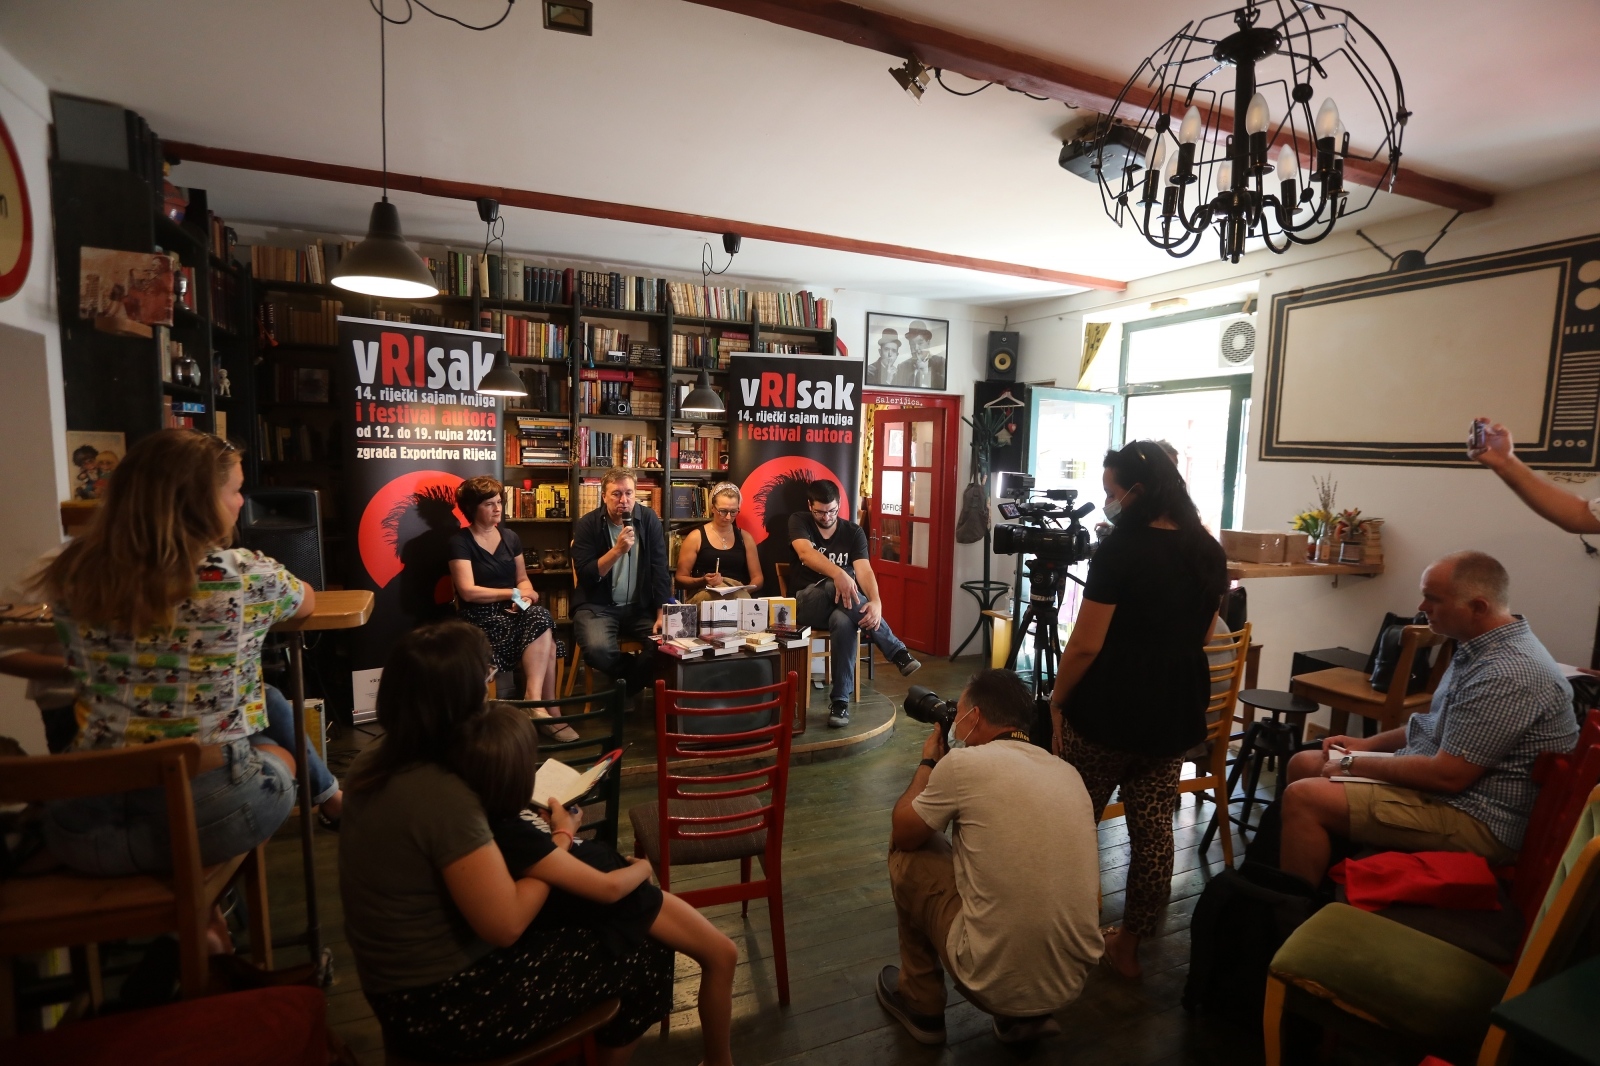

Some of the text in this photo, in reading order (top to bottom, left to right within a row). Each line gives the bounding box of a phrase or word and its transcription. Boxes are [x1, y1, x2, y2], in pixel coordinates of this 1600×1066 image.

[352, 332, 495, 391] vRIsak
[355, 385, 495, 408] 14. riječki sajam knjiga
[740, 372, 855, 410] vRIsak
[355, 402, 496, 427] i festival autora
[737, 409, 853, 426] 14. riječki sajam knjiga
[356, 425, 496, 442] od 12. do 19. rujna 2021.
[737, 424, 853, 444] i festival autora
[356, 446, 497, 461] zgrada Exportdrva Rijeka
